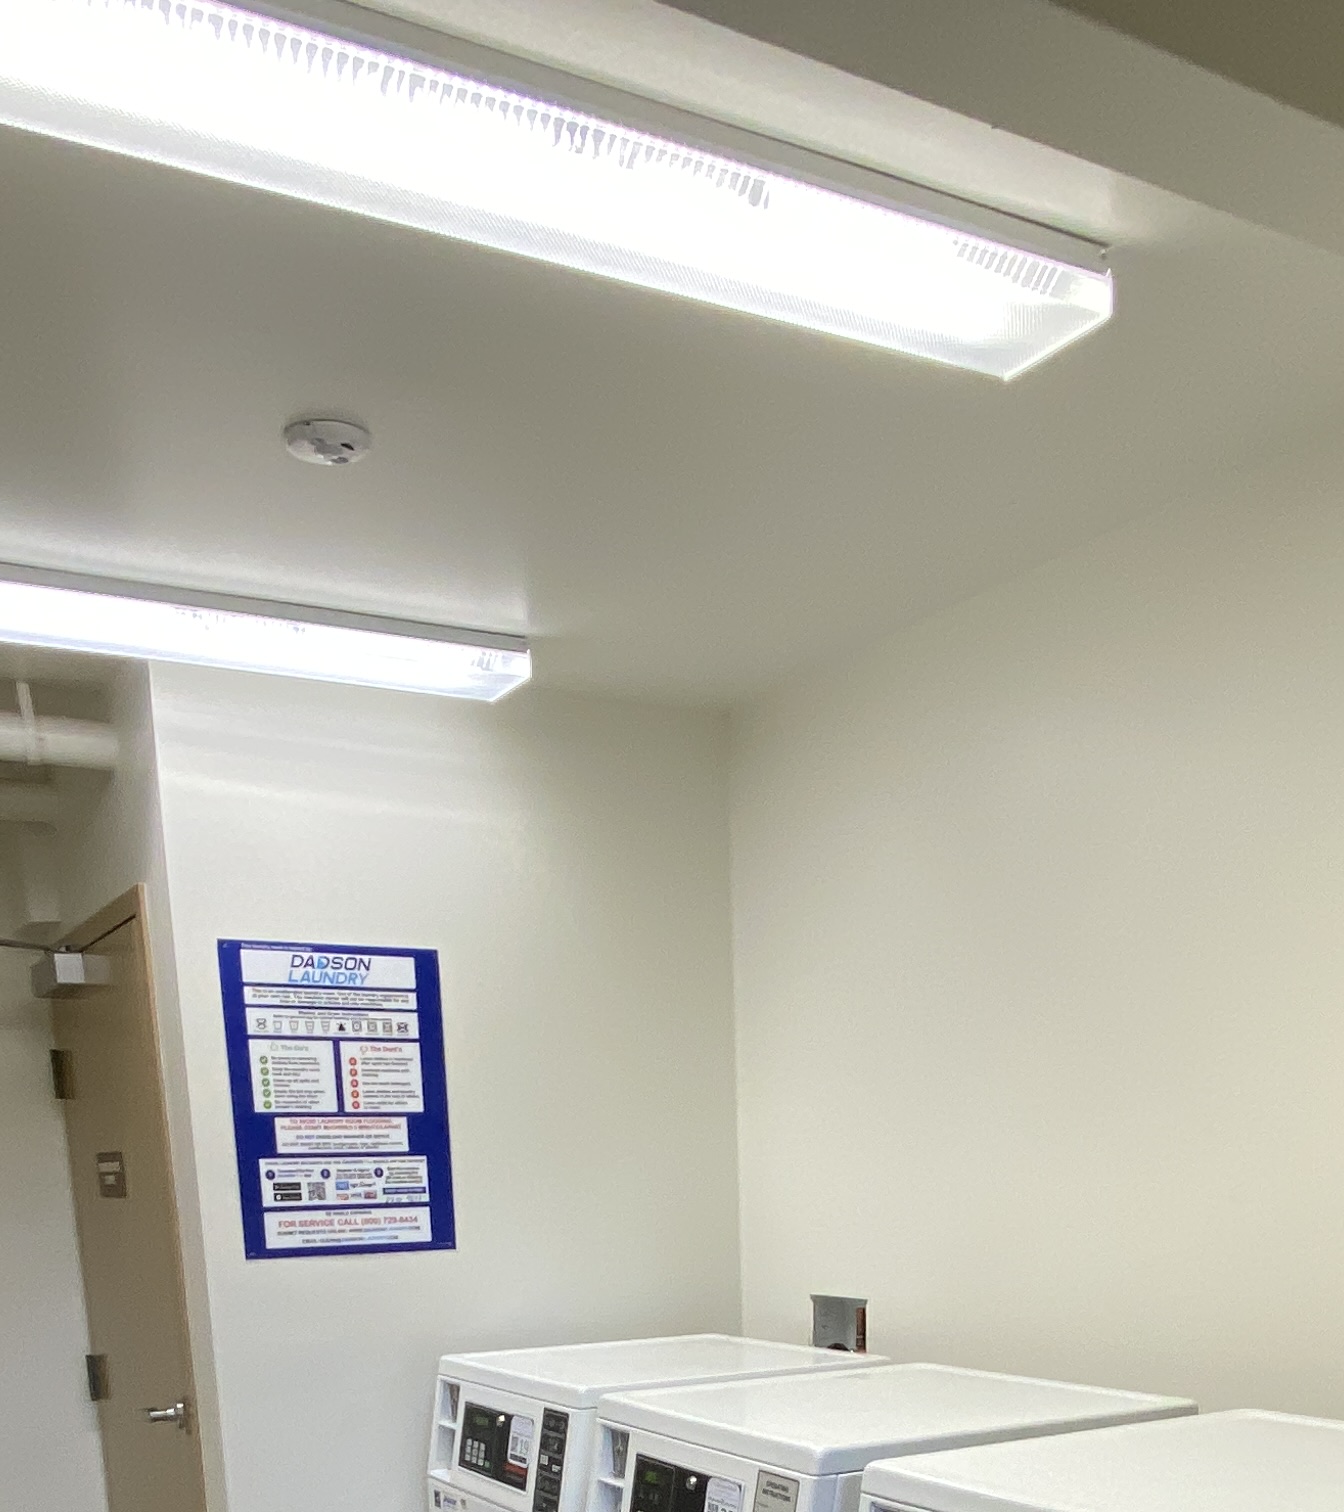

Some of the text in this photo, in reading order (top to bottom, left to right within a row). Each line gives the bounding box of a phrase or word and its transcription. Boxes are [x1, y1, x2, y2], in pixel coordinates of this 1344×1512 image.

[290, 954, 372, 971] DADSON
[287, 970, 369, 985] LAUNDRY
[278, 1220, 297, 1228] FOR
[298, 1218, 335, 1228] SERVICE
[337, 1217, 359, 1226] CALL
